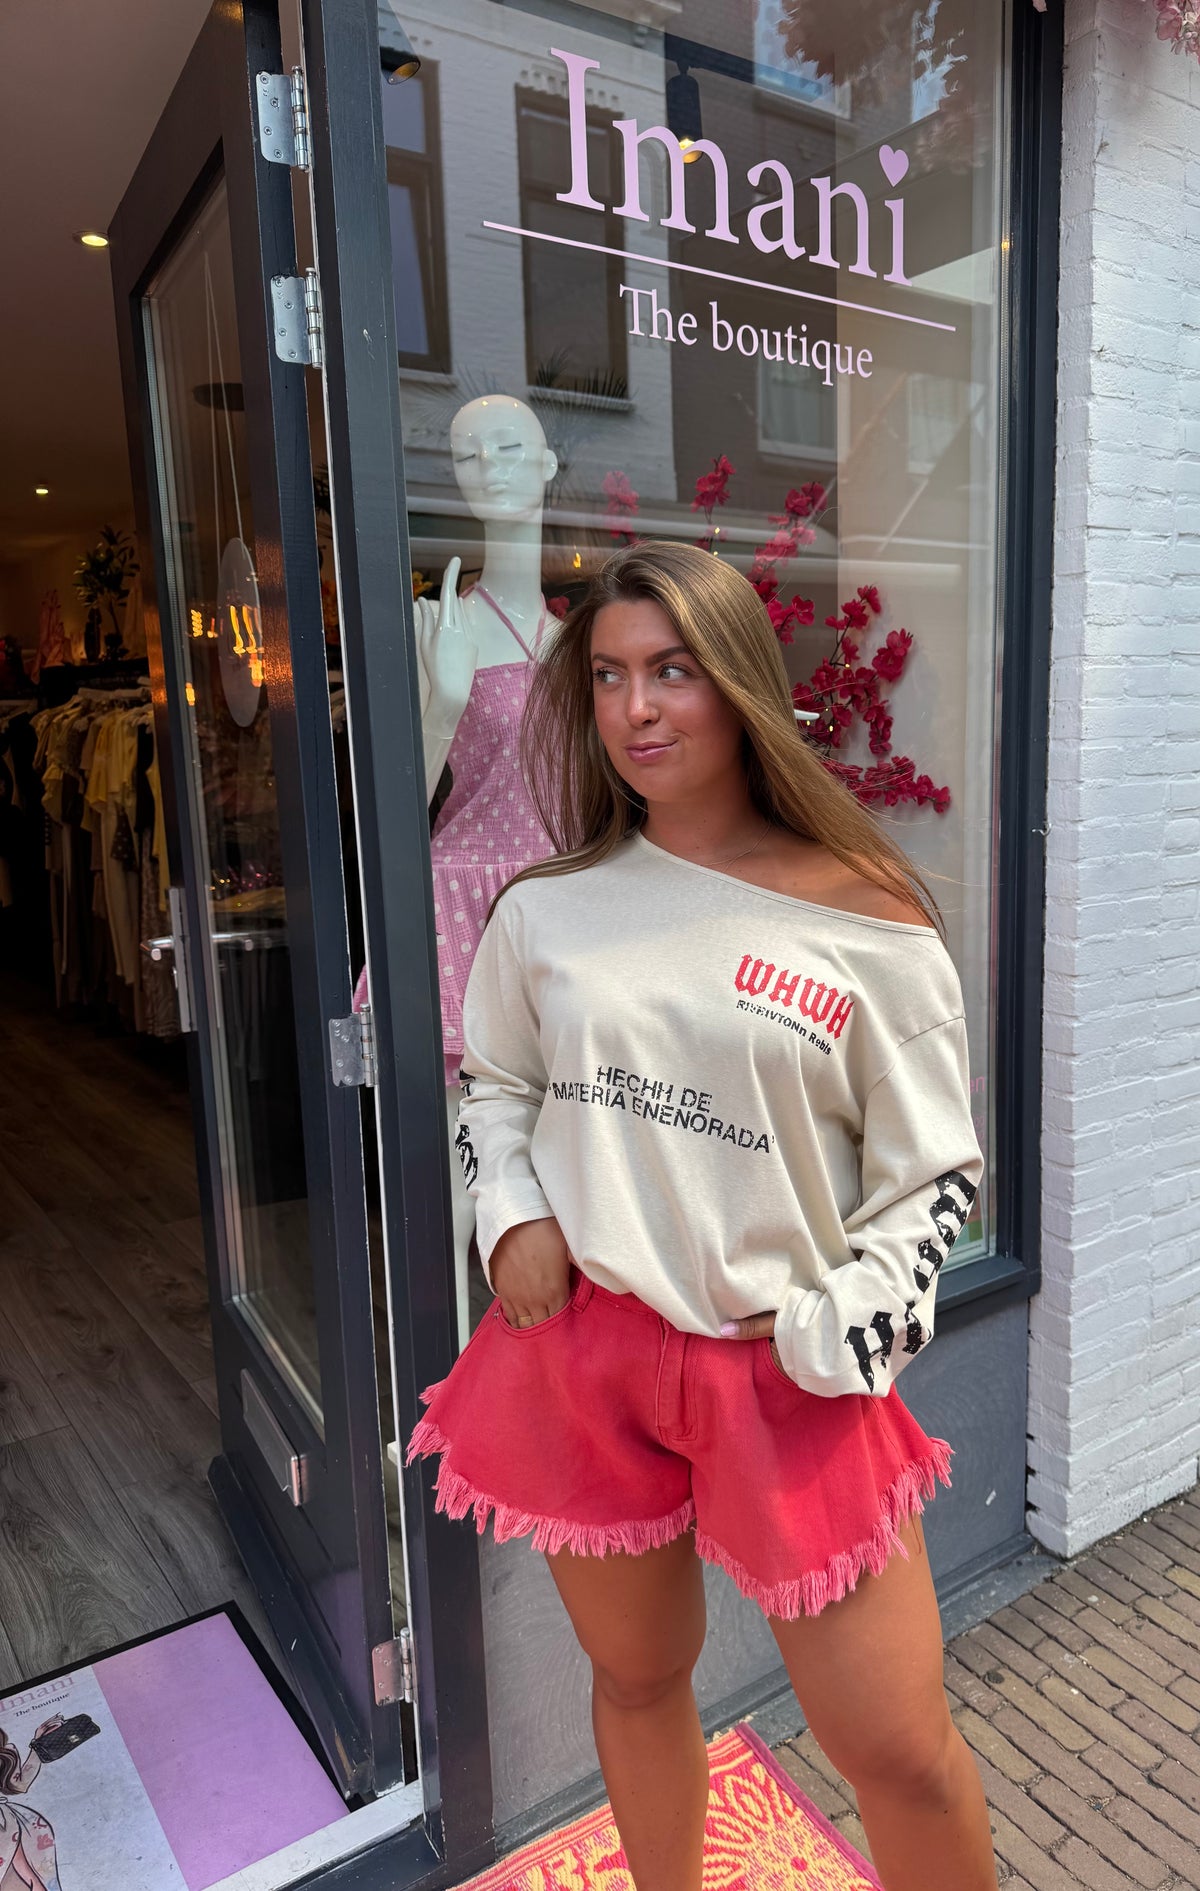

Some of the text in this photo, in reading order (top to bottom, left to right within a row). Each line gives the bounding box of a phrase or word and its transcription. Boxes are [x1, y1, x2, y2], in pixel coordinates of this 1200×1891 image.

[551, 47, 912, 286] Imani
[620, 284, 873, 387] The boutique
[680, 1087, 713, 1113] DE
[14, 1692, 70, 1717] The boutique
